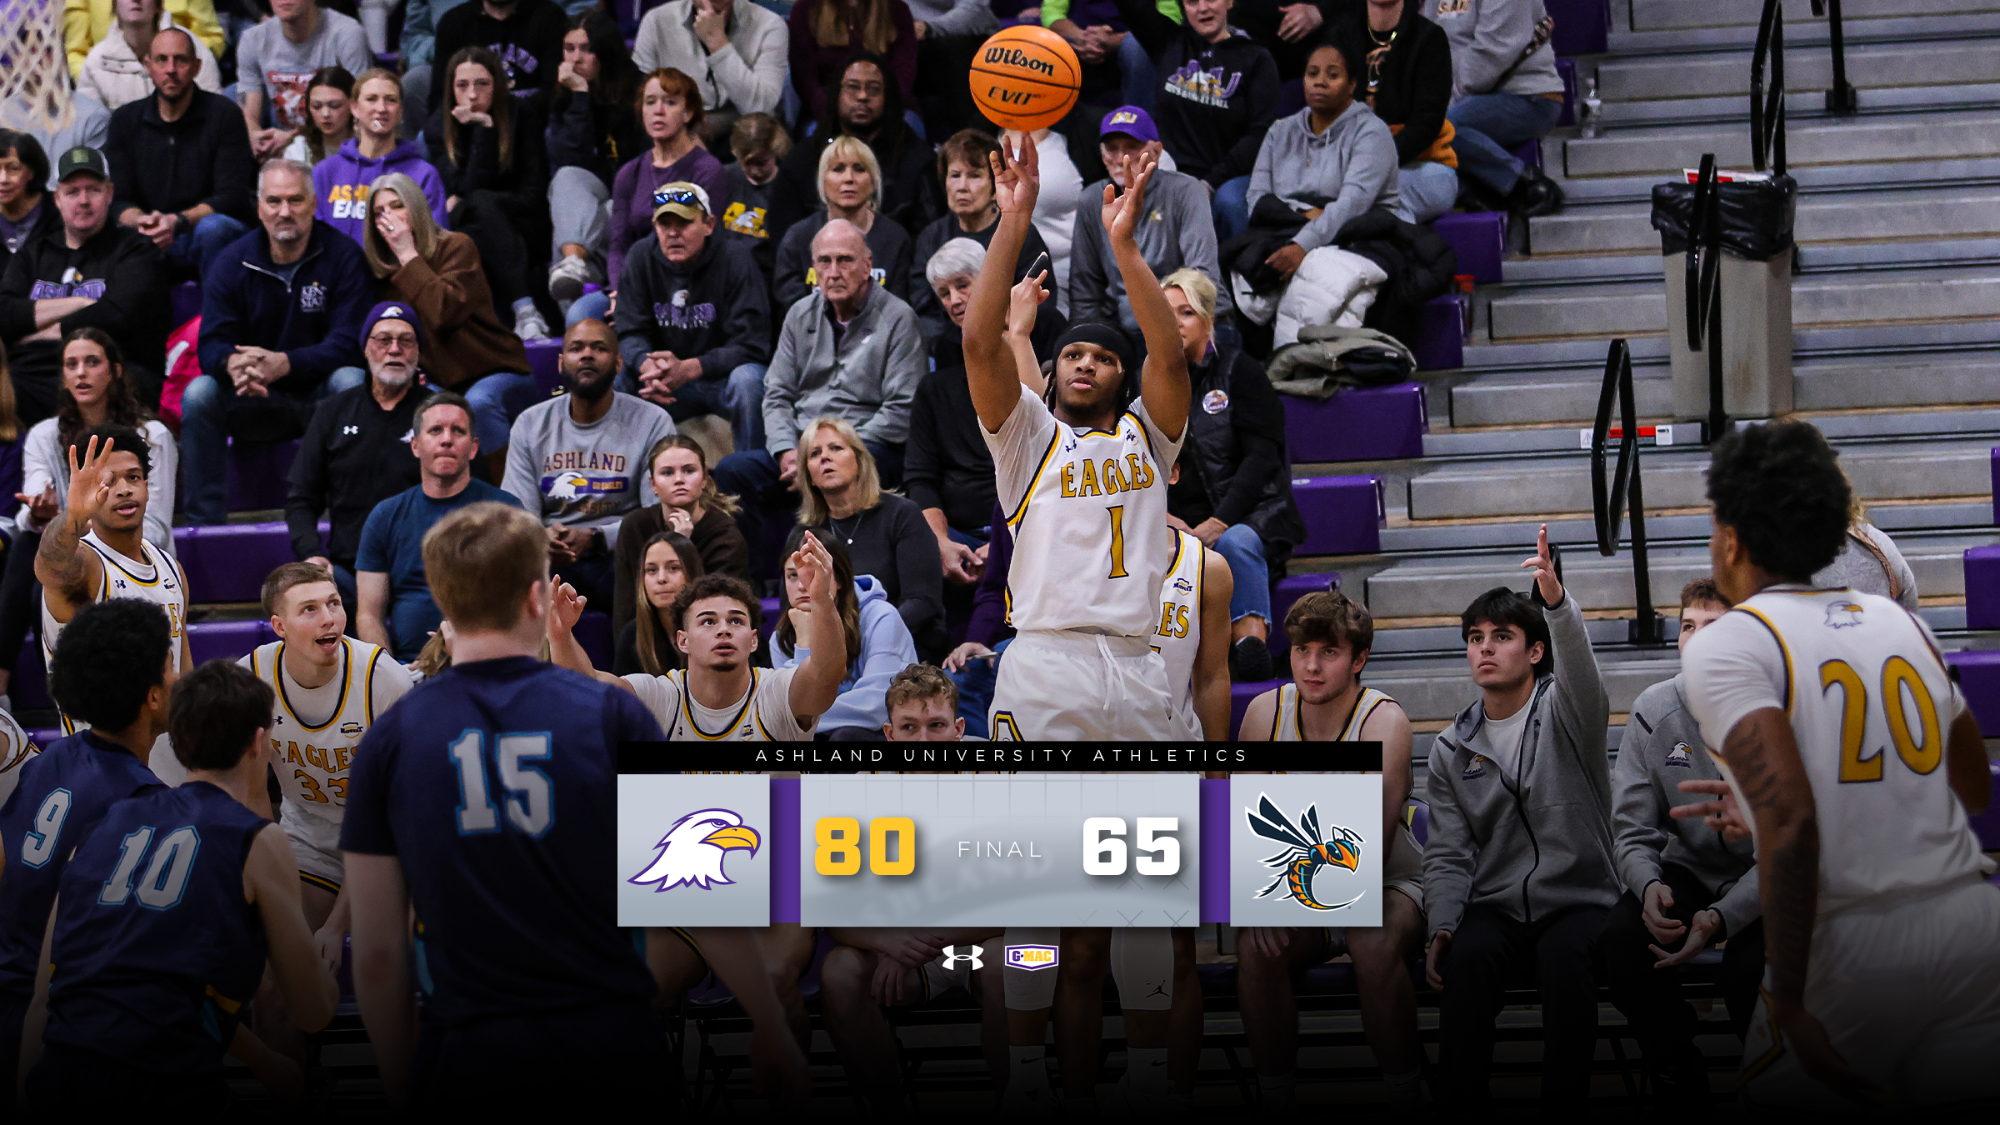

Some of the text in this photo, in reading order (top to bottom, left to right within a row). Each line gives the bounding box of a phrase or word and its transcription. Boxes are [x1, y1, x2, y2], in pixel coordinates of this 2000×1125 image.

[984, 46, 1054, 77] Wilson
[332, 199, 368, 220] EAG
[542, 451, 628, 474] ASHLAND
[1060, 451, 1155, 499] EAGLES
[1105, 504, 1130, 580] 1
[1154, 601, 1190, 639] ES
[1817, 654, 1943, 785] 20
[271, 738, 360, 774] EAGLE
[448, 727, 555, 839] 15
[20, 786, 73, 870] 9
[96, 824, 202, 912] 10
